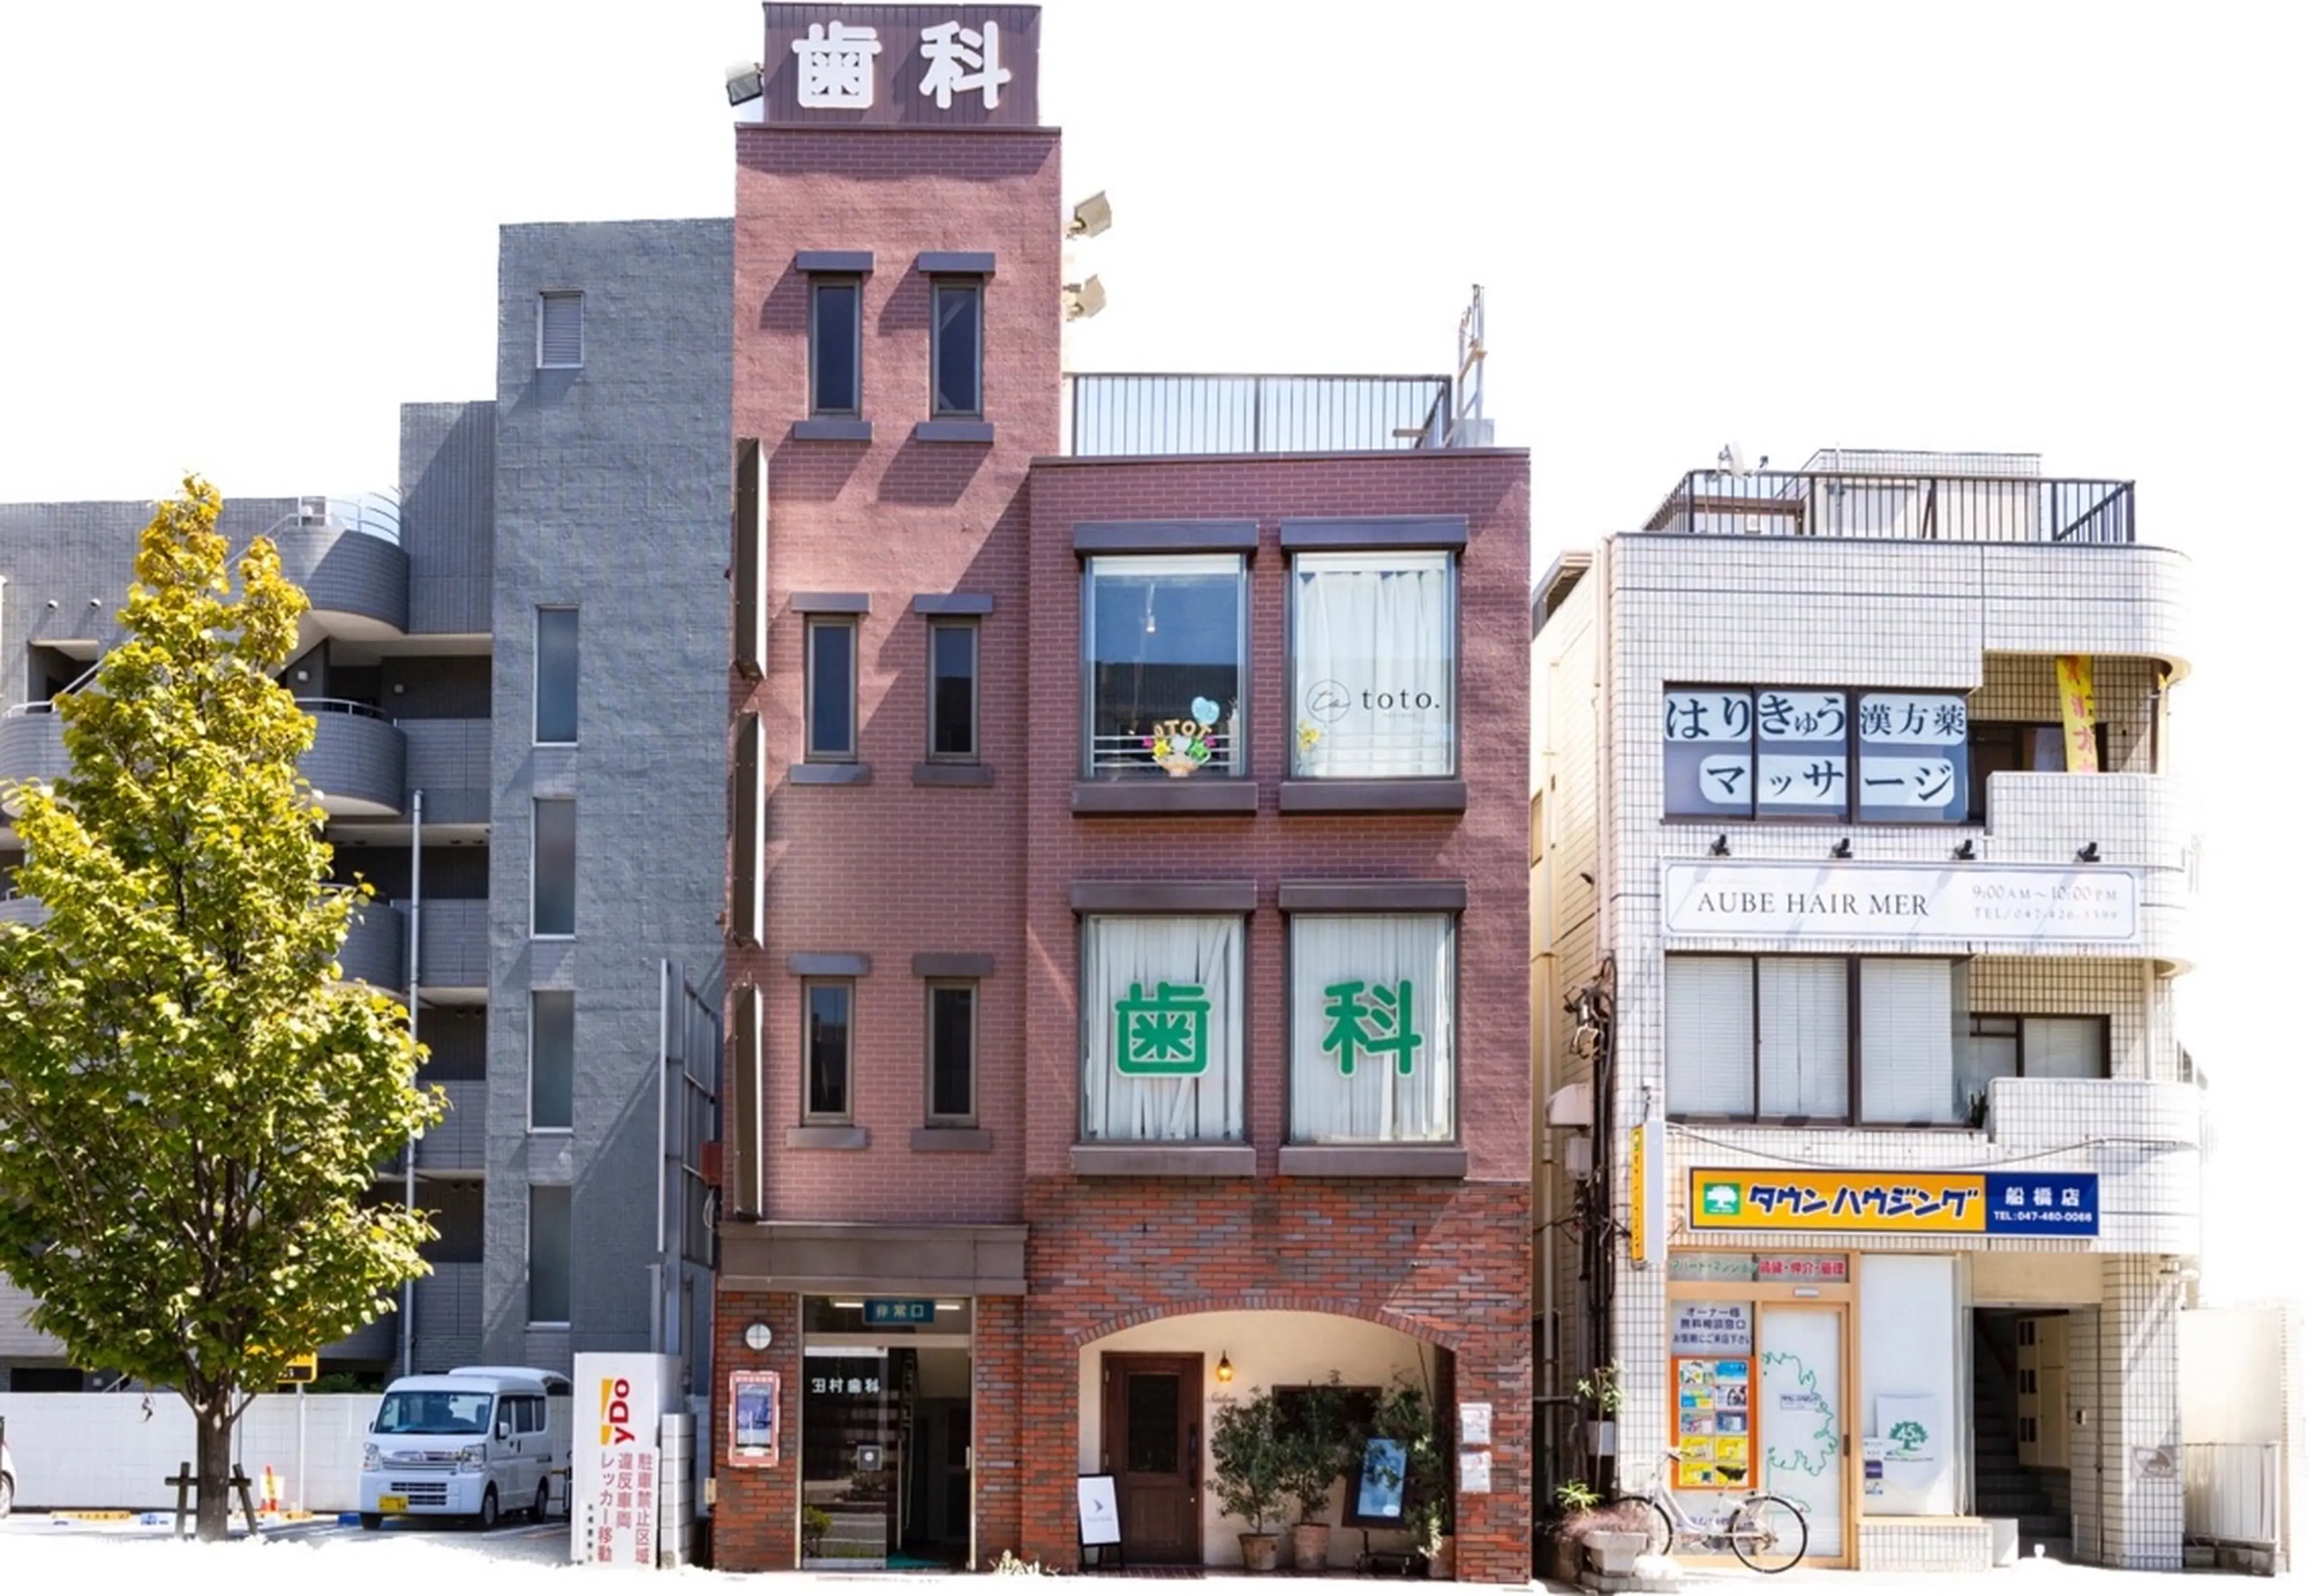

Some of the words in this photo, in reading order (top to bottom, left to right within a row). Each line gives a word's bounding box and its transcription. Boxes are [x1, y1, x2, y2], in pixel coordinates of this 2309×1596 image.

[791, 20, 1011, 109] 歯科
[1363, 689, 1440, 710] toto.
[1667, 696, 1749, 738] はり
[1759, 695, 1844, 736] きゅう
[1862, 702, 1964, 736] 漢方薬
[1706, 760, 1951, 802] マッサージ
[1697, 892, 1774, 913] AUBE
[1786, 893, 1859, 915] HAIR
[1869, 894, 1928, 916] MER
[1749, 1185, 1978, 1218] タウンハウジング
[2005, 1186, 2080, 1206] 船橋店
[598, 1451, 615, 1562] レッカー移動
